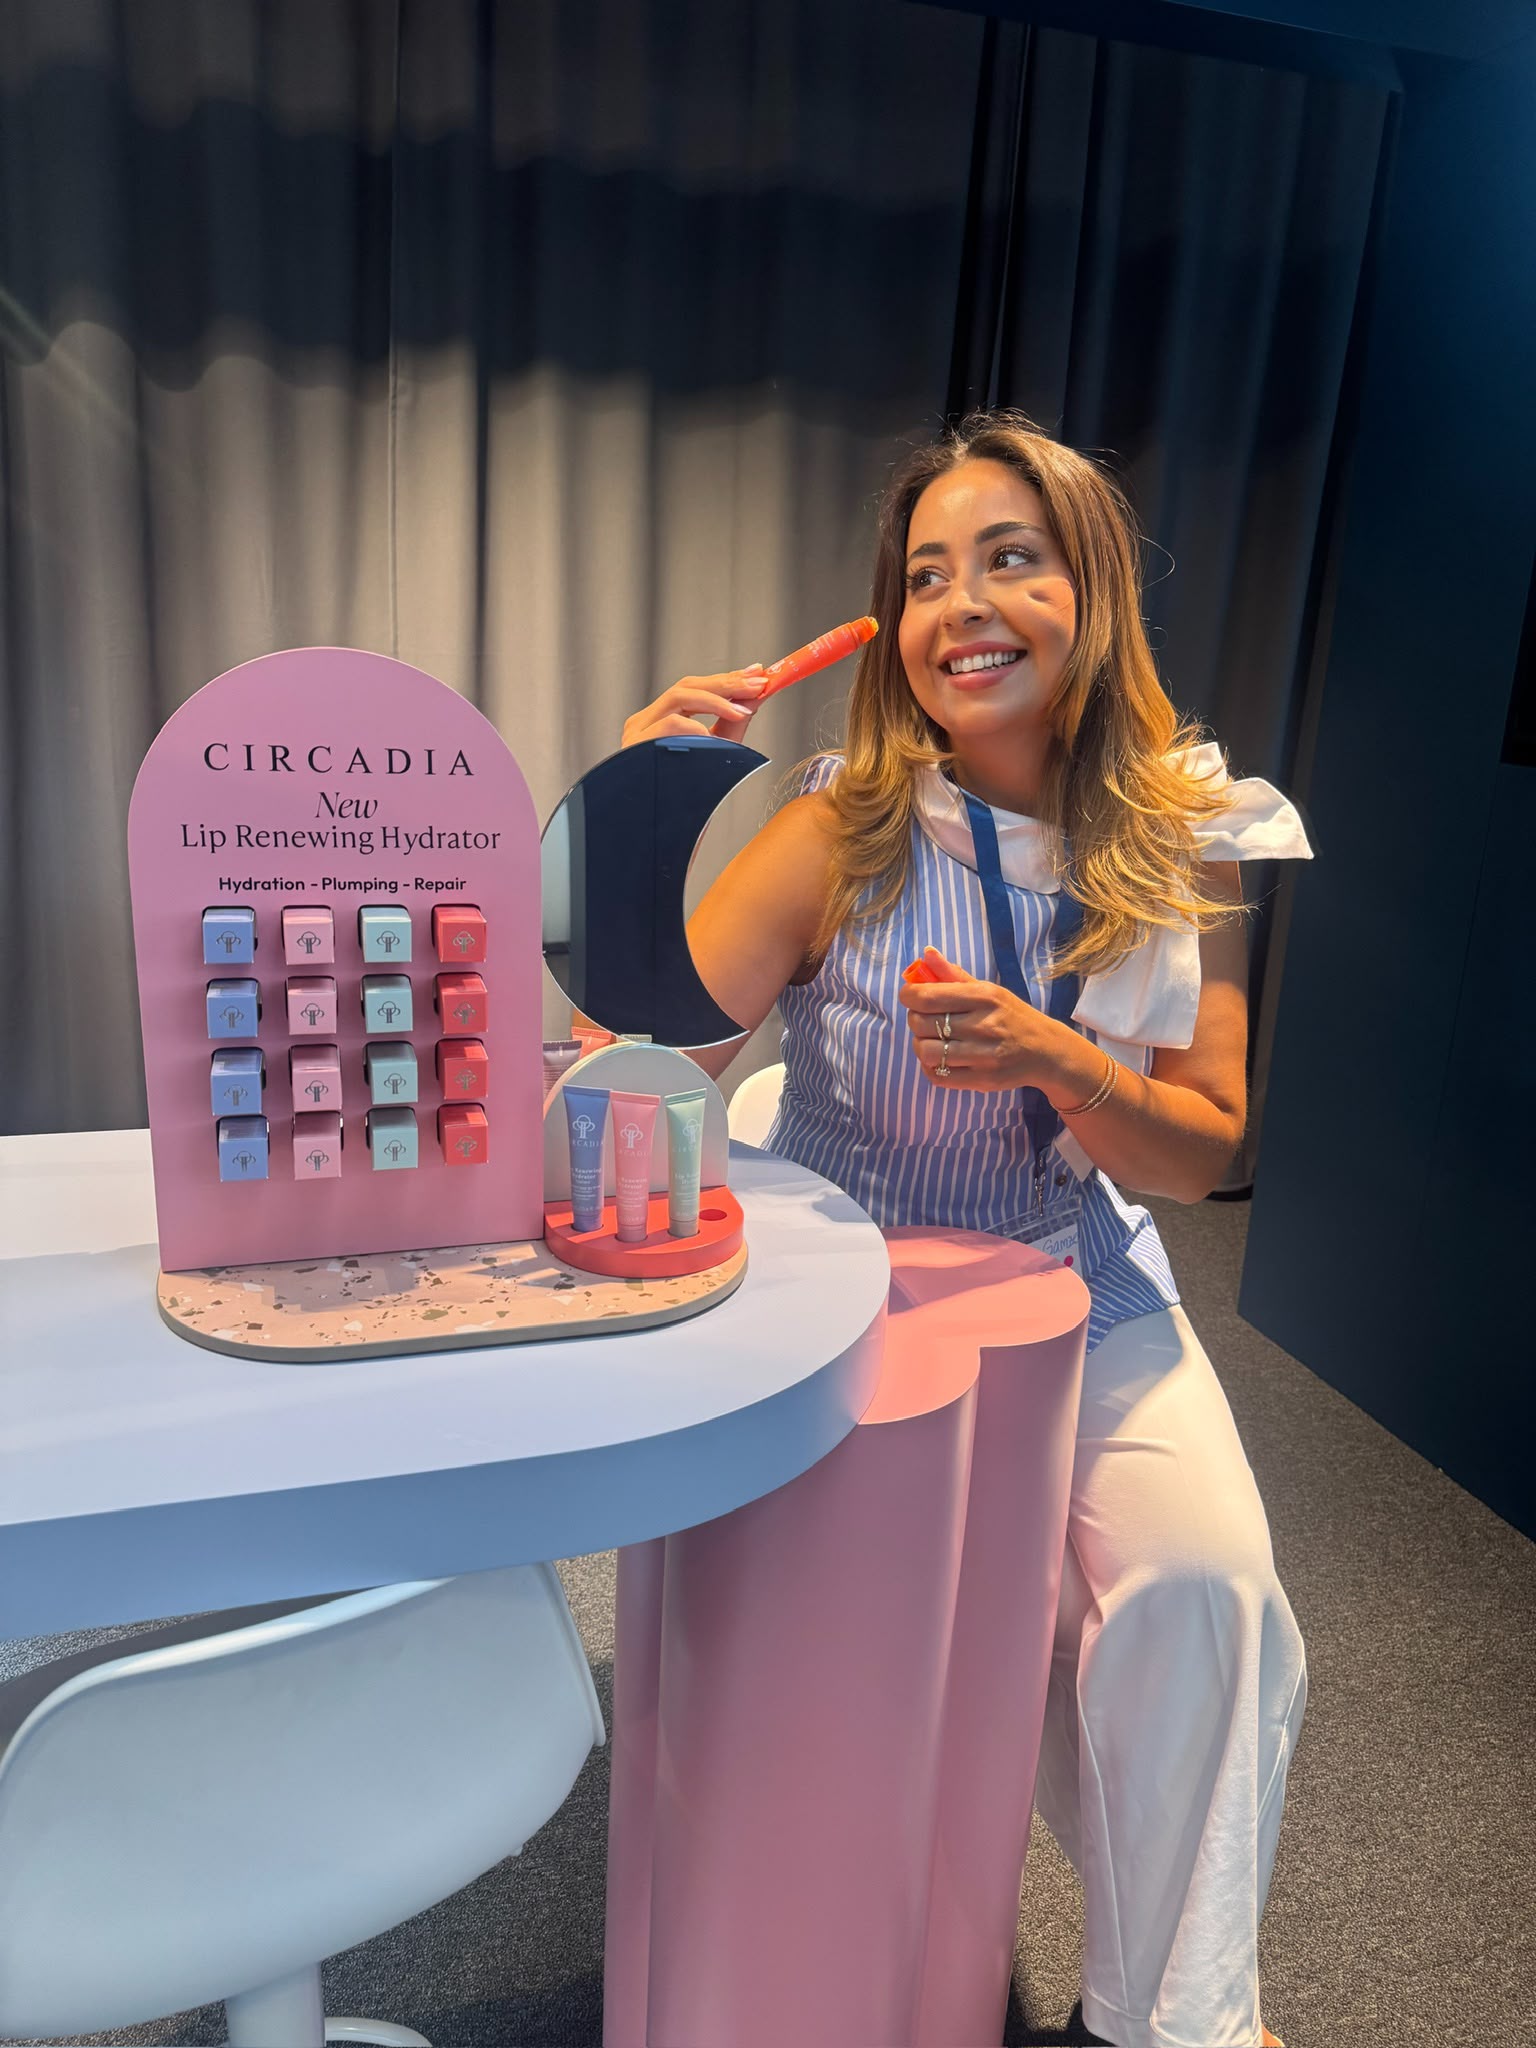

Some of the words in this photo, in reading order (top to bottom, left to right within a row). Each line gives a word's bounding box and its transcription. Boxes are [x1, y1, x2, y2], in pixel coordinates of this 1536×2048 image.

[203, 742, 475, 777] CIRCADIA
[314, 790, 379, 820] New
[180, 823, 227, 854] Lip
[234, 824, 375, 856] Renewing
[380, 825, 502, 856] Hydrator
[218, 876, 306, 894] Hydration
[321, 877, 399, 895] Plumping
[414, 878, 467, 893] Repair
